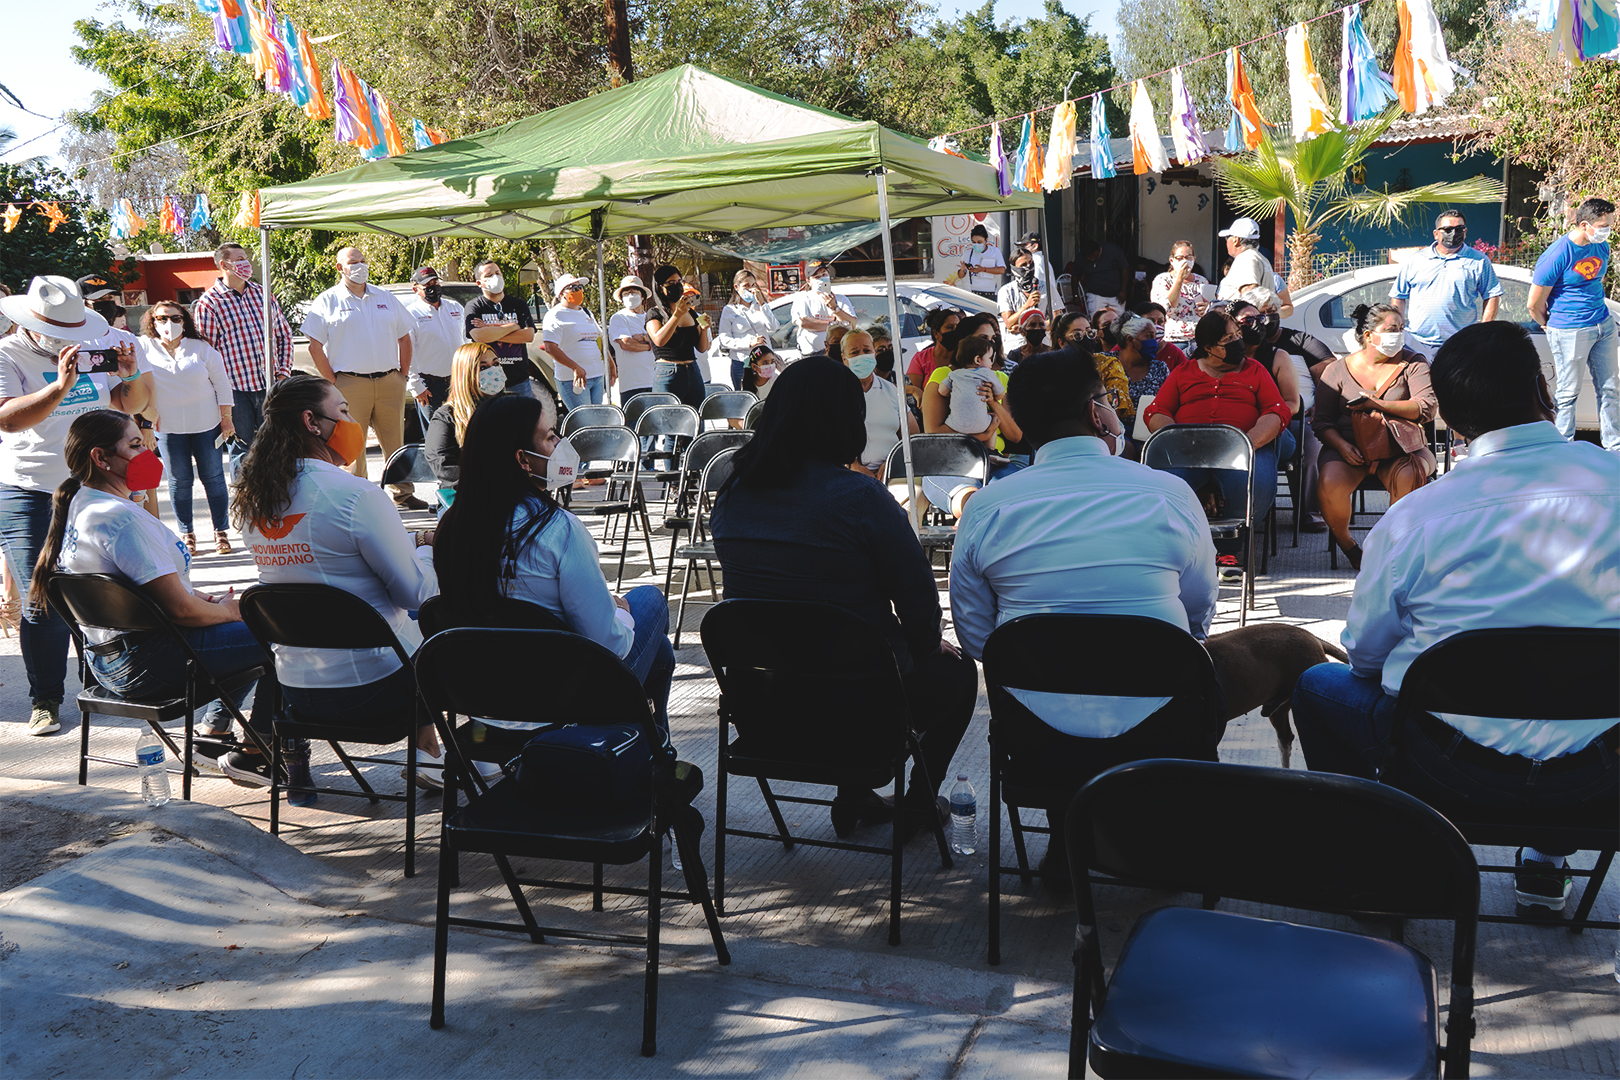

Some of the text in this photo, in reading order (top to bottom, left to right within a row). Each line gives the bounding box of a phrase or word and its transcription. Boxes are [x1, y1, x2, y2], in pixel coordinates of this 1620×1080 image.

[481, 312, 518, 321] MILNA
[66, 387, 93, 398] anza
[252, 543, 310, 554] MOVIMIENTO
[254, 554, 314, 566] CIUDADANO
